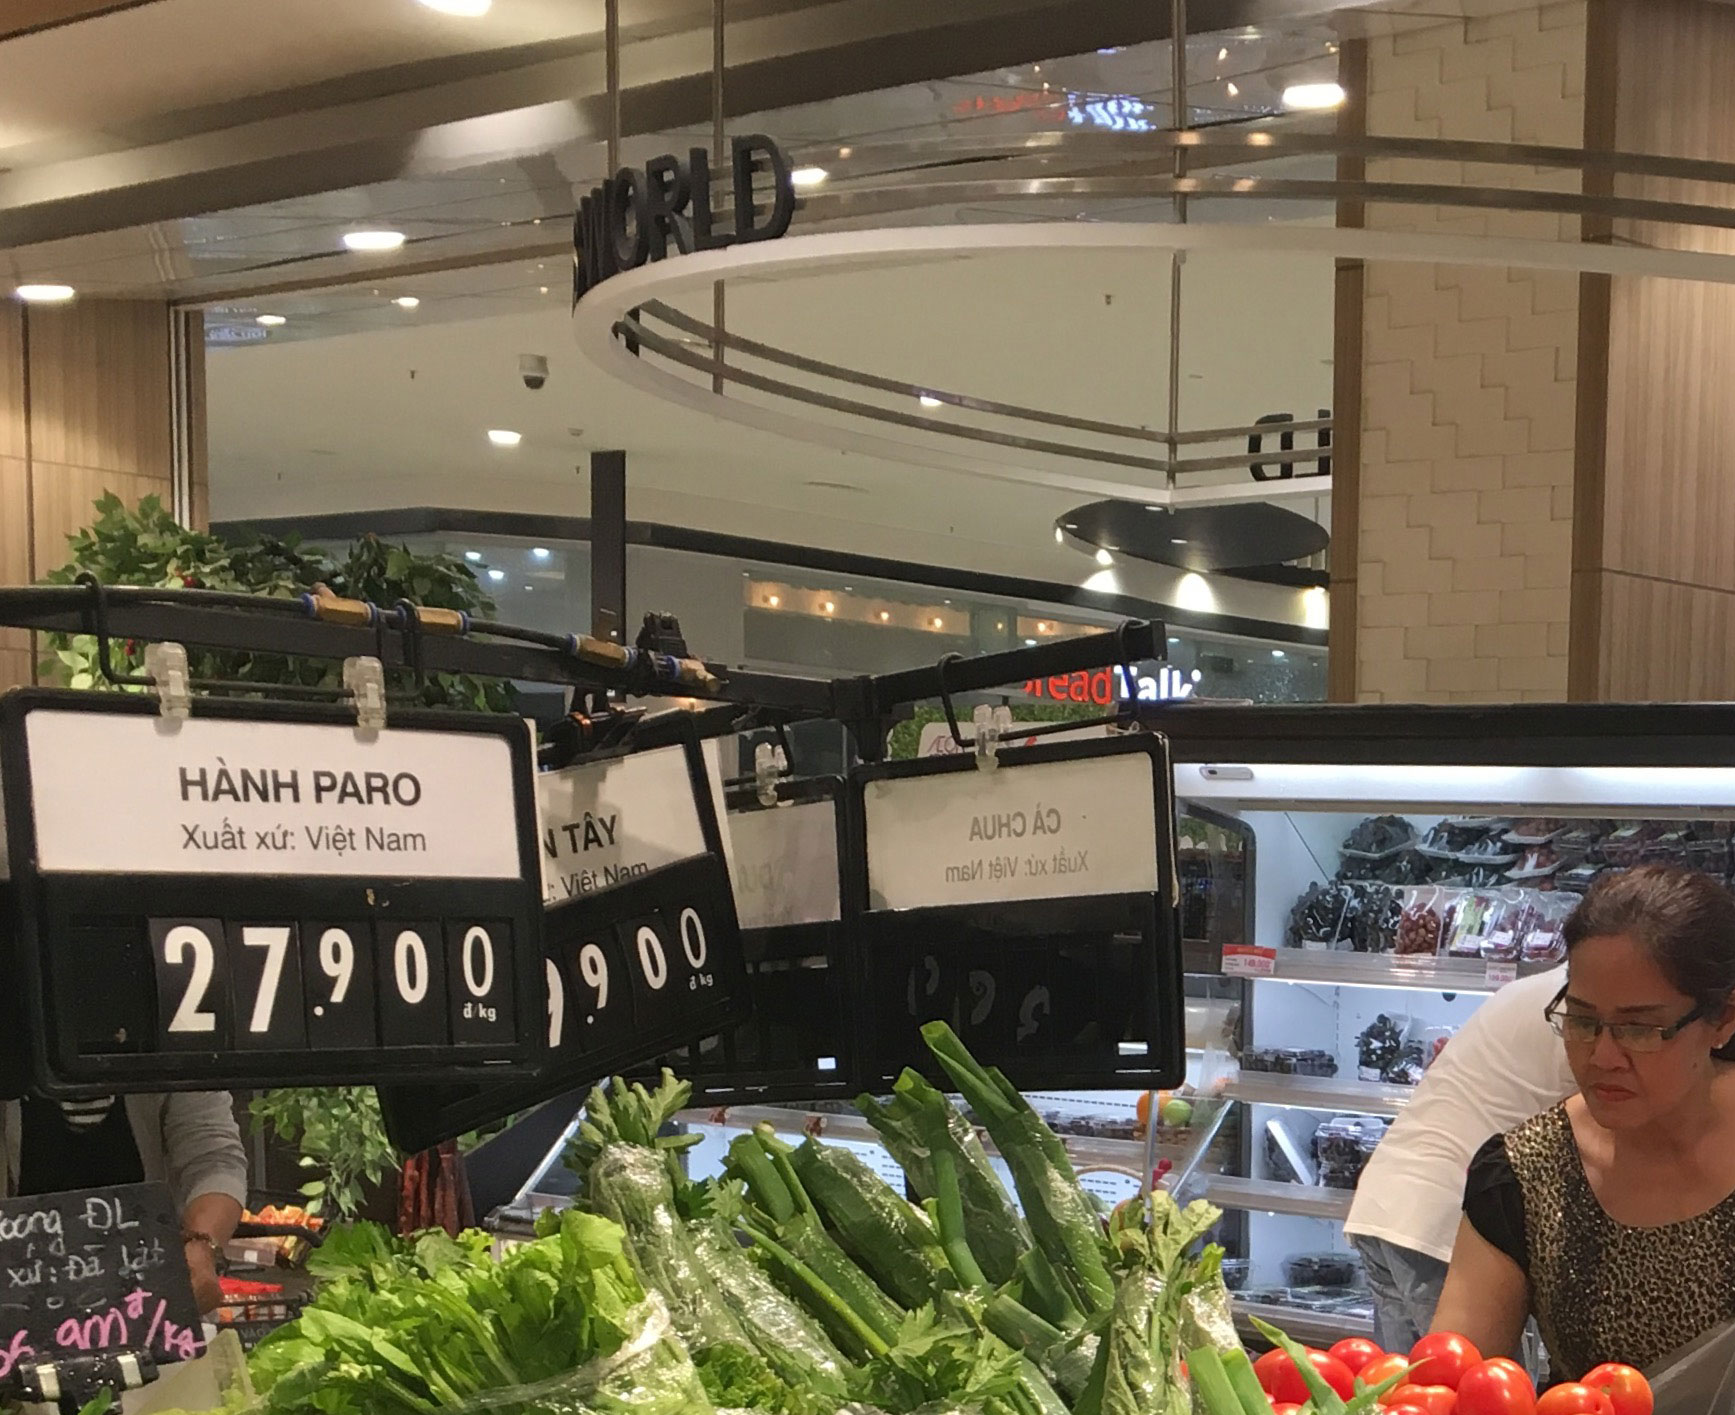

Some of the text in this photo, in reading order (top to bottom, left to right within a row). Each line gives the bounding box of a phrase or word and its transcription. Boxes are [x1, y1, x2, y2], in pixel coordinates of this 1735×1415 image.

[179, 756, 422, 806] HÀNH PARO
[181, 816, 427, 857] Xuất xứ: Việt Nam
[562, 811, 617, 854] TÂY
[164, 926, 495, 1032] 27.900
